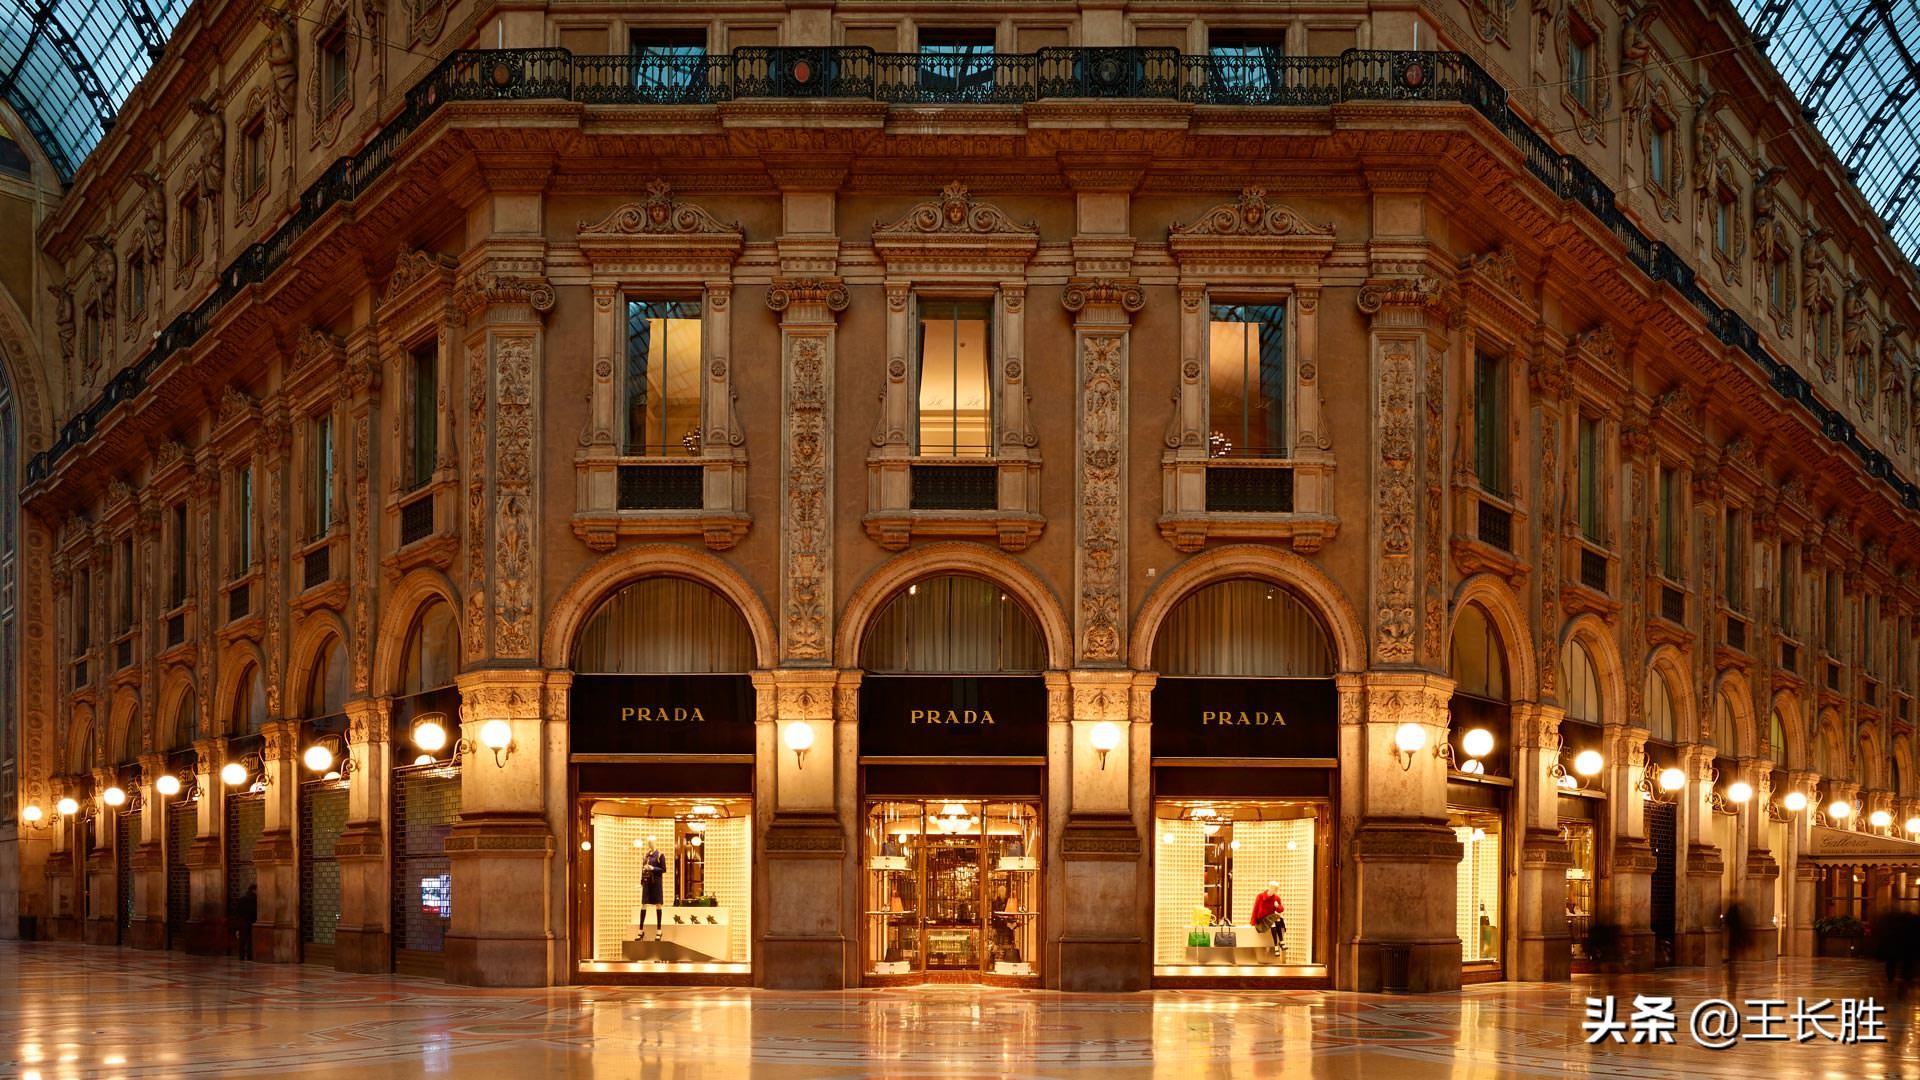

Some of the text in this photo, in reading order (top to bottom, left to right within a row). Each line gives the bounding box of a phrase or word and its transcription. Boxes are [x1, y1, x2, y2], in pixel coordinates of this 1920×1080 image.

[621, 707, 705, 721] PRADA
[911, 710, 995, 724] PRADA
[1202, 711, 1287, 726] PRADA
